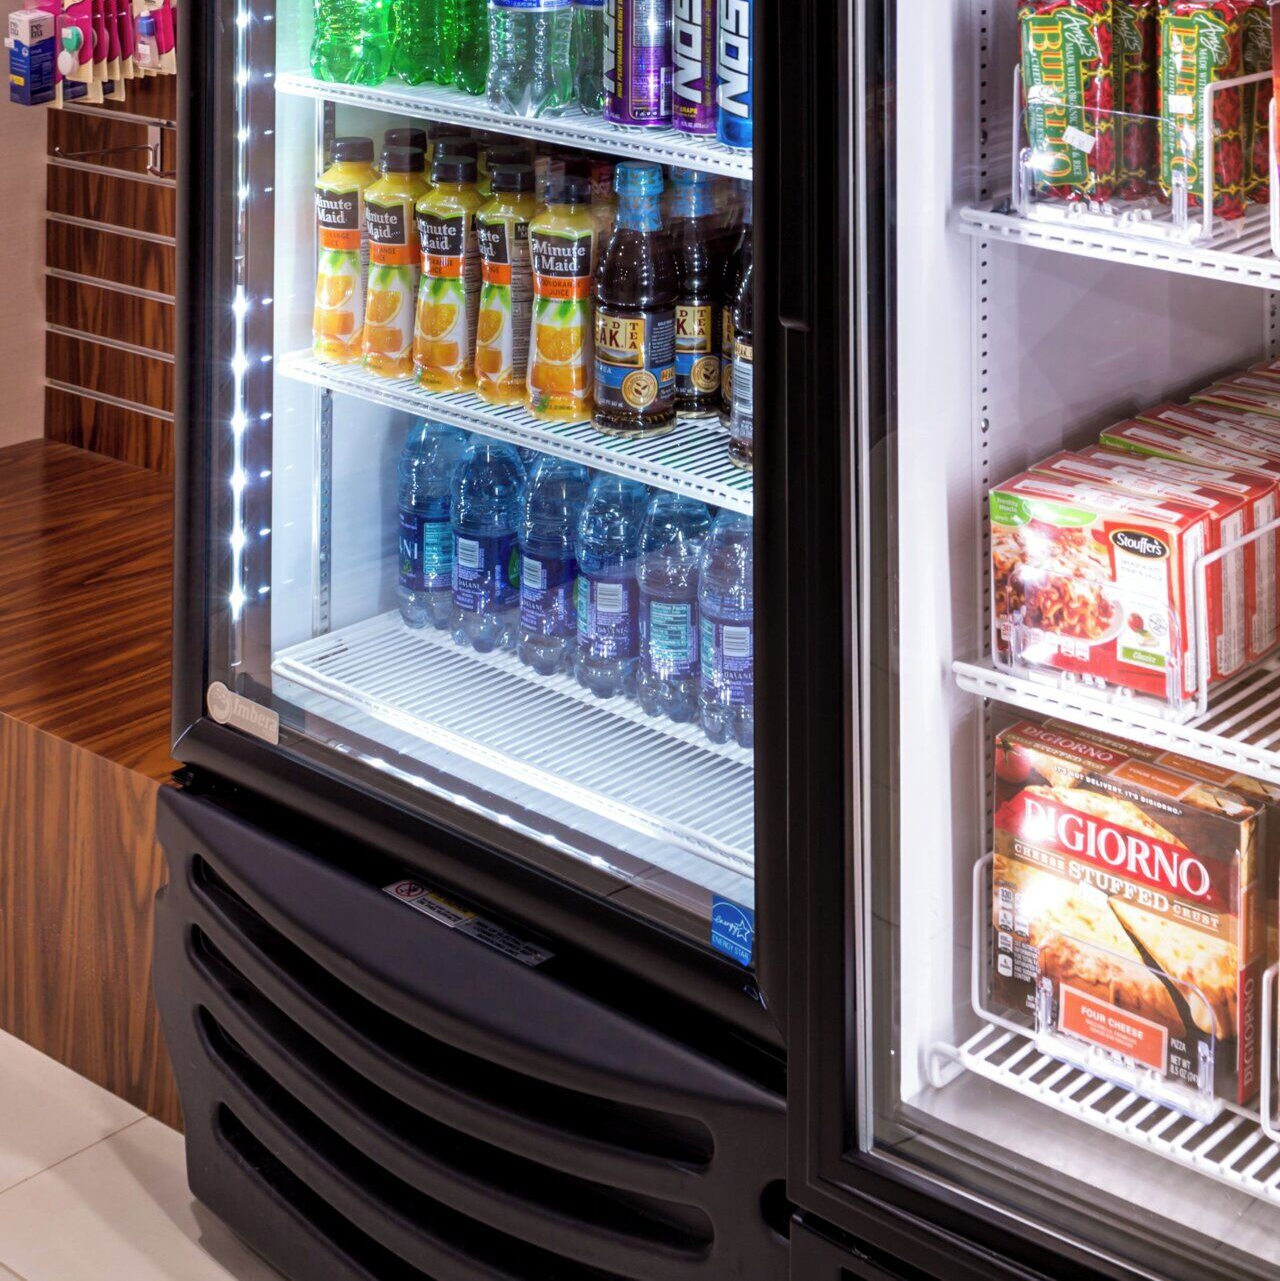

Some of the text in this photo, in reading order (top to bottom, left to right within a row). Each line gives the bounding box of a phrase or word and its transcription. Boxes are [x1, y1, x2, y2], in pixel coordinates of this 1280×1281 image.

[536, 240, 586, 257] Minute
[541, 255, 579, 272] Maid
[1116, 533, 1163, 556] Stouffer's
[1013, 841, 1220, 928] CHEESE STUFFED CRUST
[1081, 1005, 1106, 1024] FOUR
[1108, 1014, 1144, 1040] CHEESE
[1170, 1037, 1186, 1052] PIZZA
